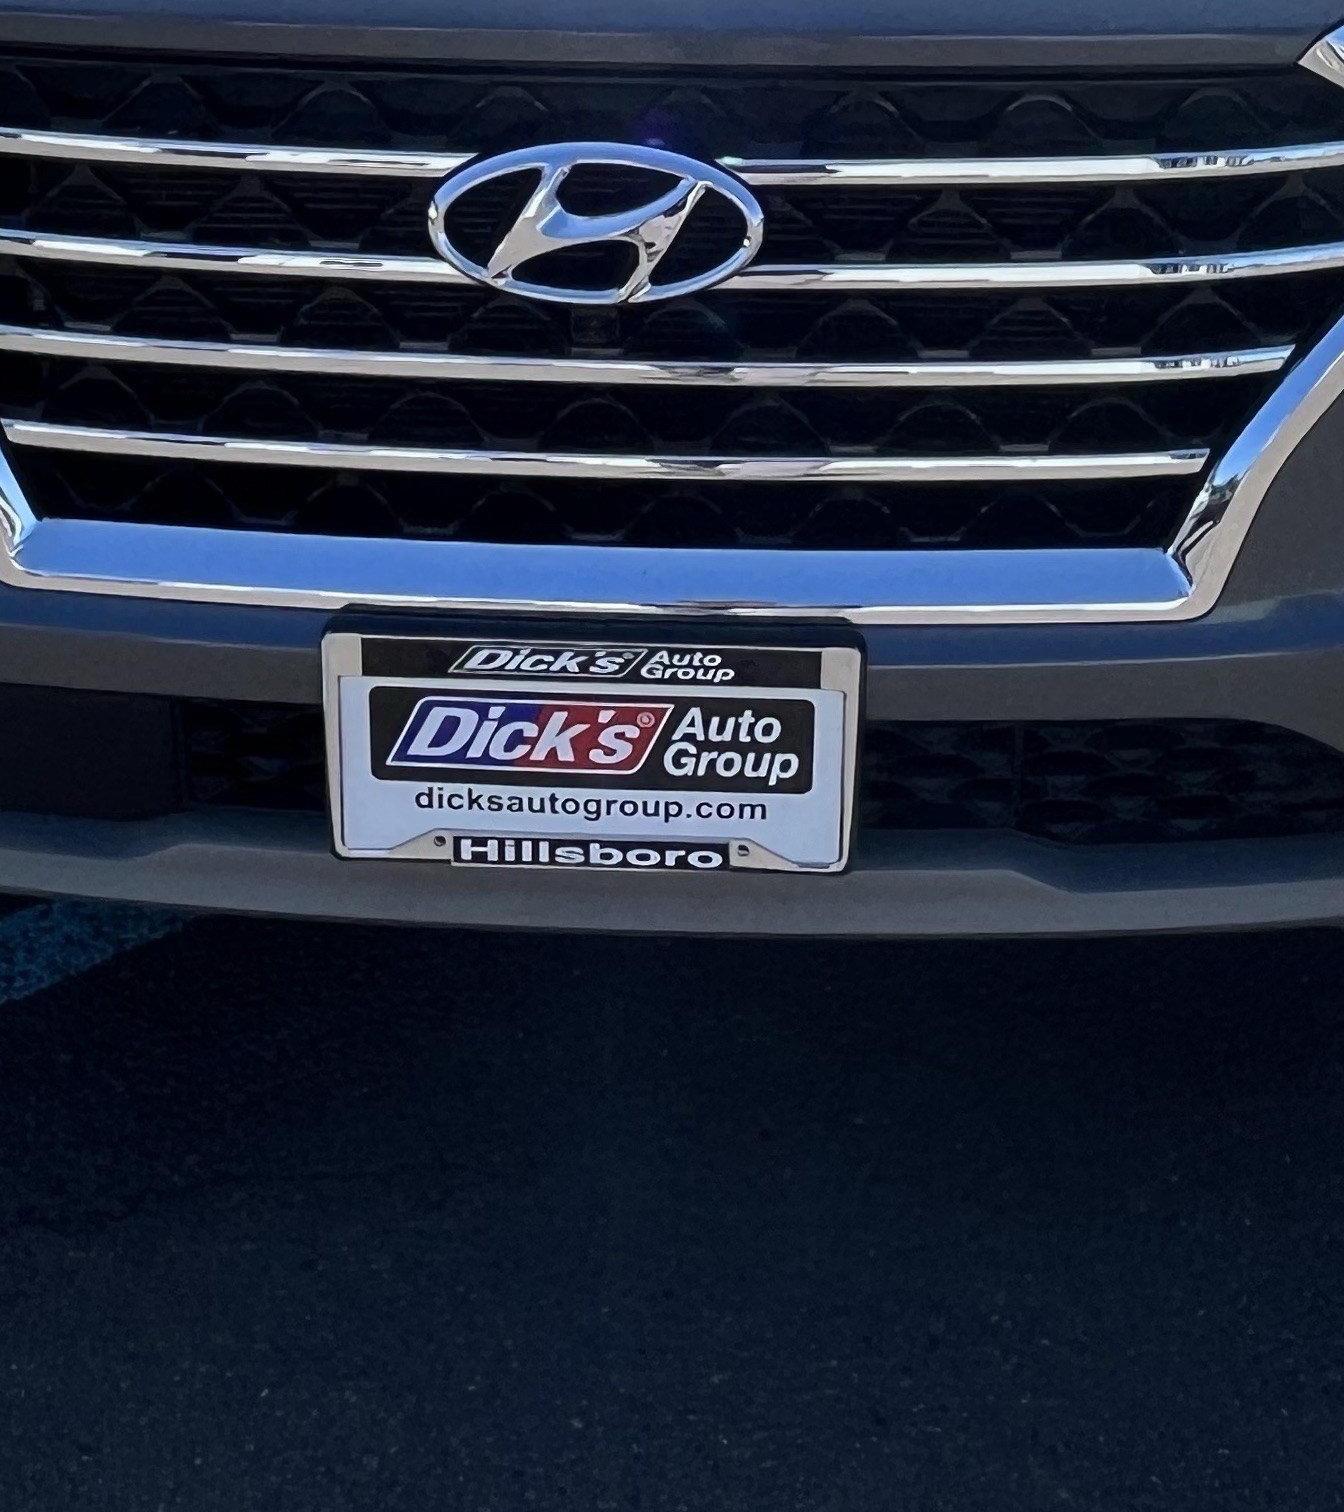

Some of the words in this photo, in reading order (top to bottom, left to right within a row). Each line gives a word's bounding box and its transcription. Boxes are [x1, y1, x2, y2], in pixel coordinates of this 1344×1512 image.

[640, 665, 735, 683] Group
[651, 650, 722, 667] Auto
[671, 707, 782, 743] Auto
[663, 741, 799, 787] Group
[415, 786, 767, 821] dicksautogroup.com
[459, 839, 723, 869] Hillsboro
